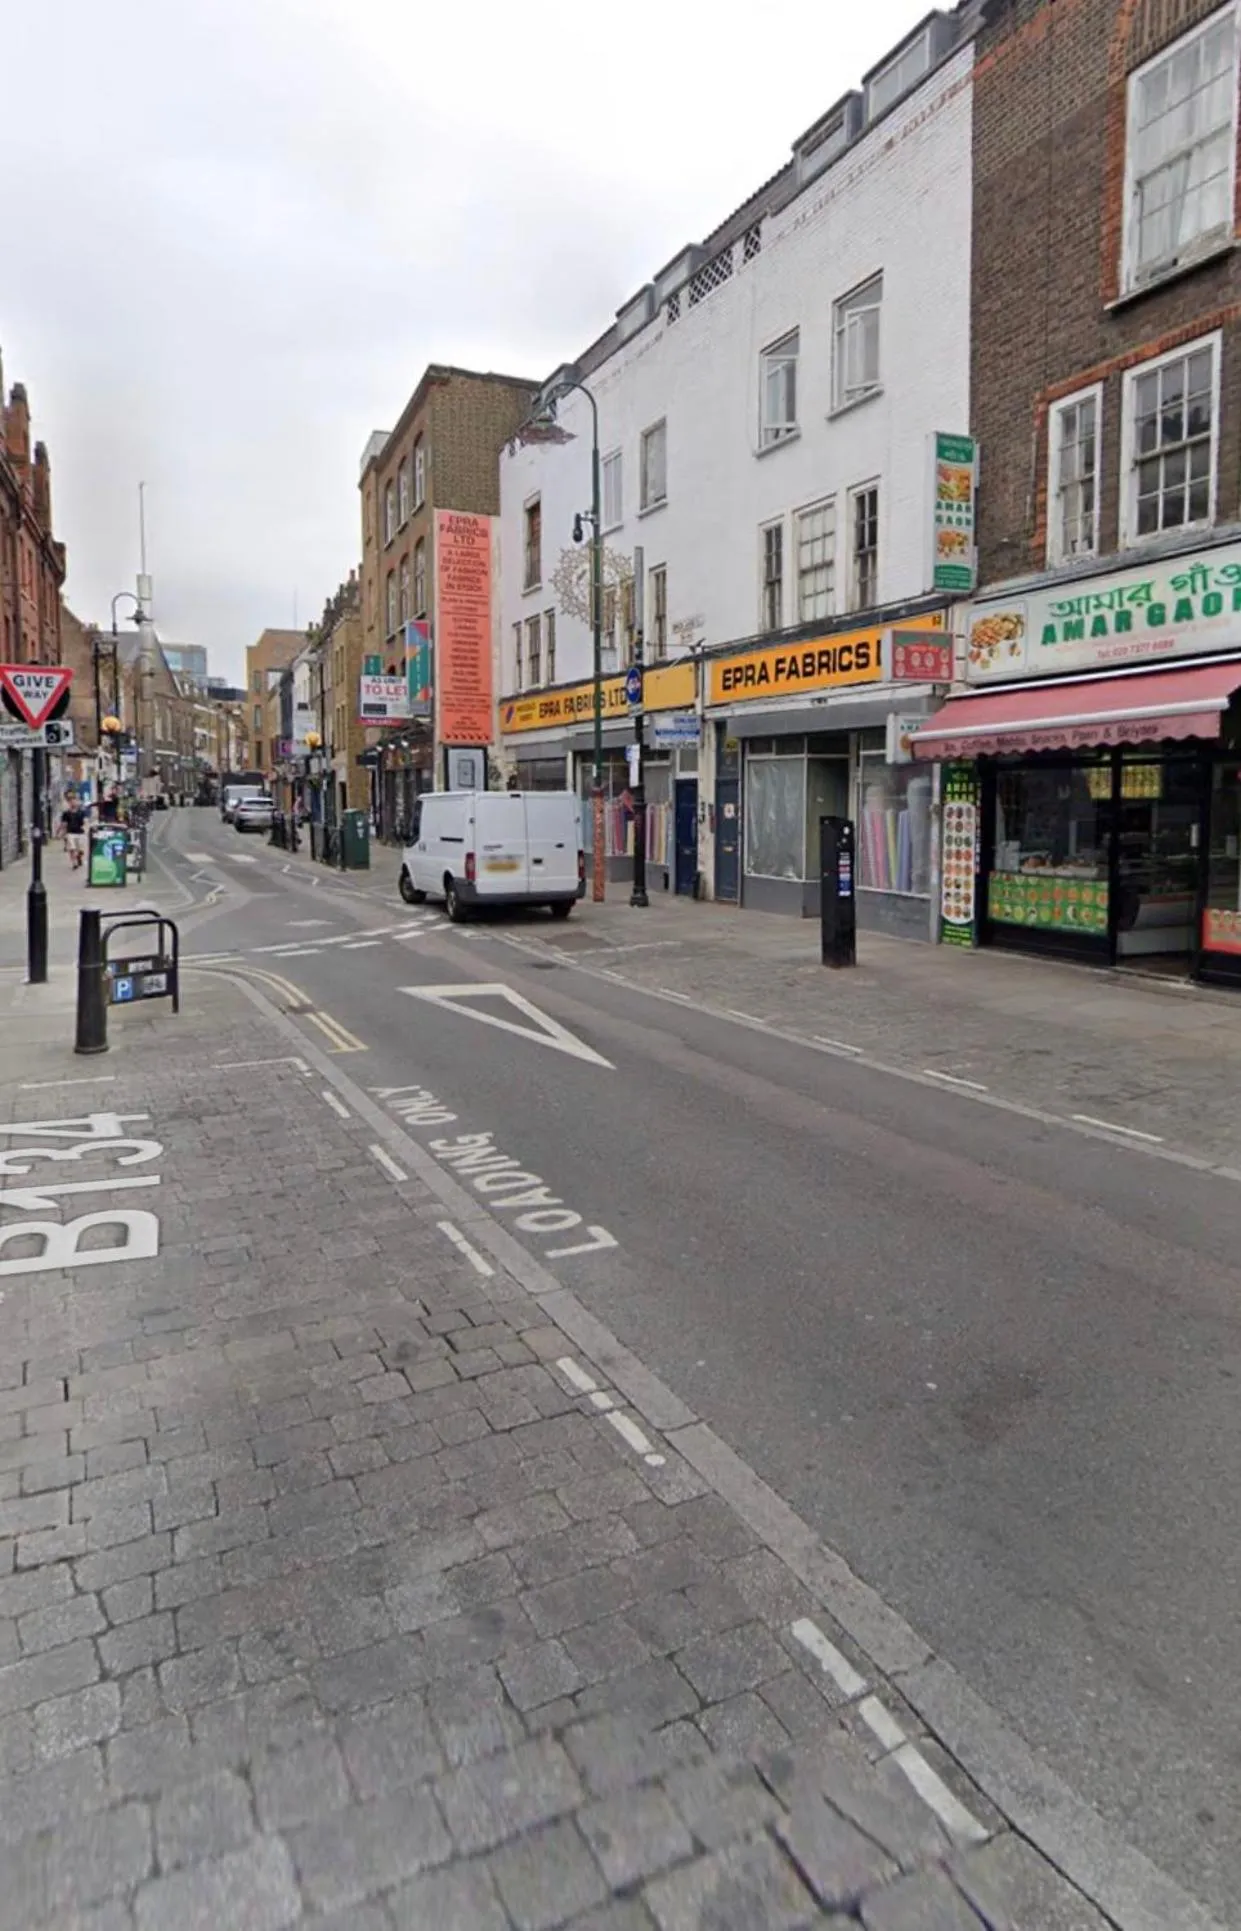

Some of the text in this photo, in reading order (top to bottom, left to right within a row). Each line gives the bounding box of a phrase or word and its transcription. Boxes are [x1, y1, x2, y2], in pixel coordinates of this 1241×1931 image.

[448, 515, 479, 526] EPRA
[440, 523, 488, 538] FABRICS
[453, 535, 476, 545] LTD
[1041, 609, 1133, 646] AMAR
[722, 661, 769, 691] EPRA
[774, 642, 869, 682] FABRICS
[13, 674, 55, 688] GIVE
[24, 690, 47, 699] WAY
[364, 684, 381, 695] TO
[539, 697, 562, 719] EPRA
[564, 691, 606, 715] FABRIS
[608, 687, 627, 707] LTD
[367, 1084, 619, 1259] LOADING ONLY
